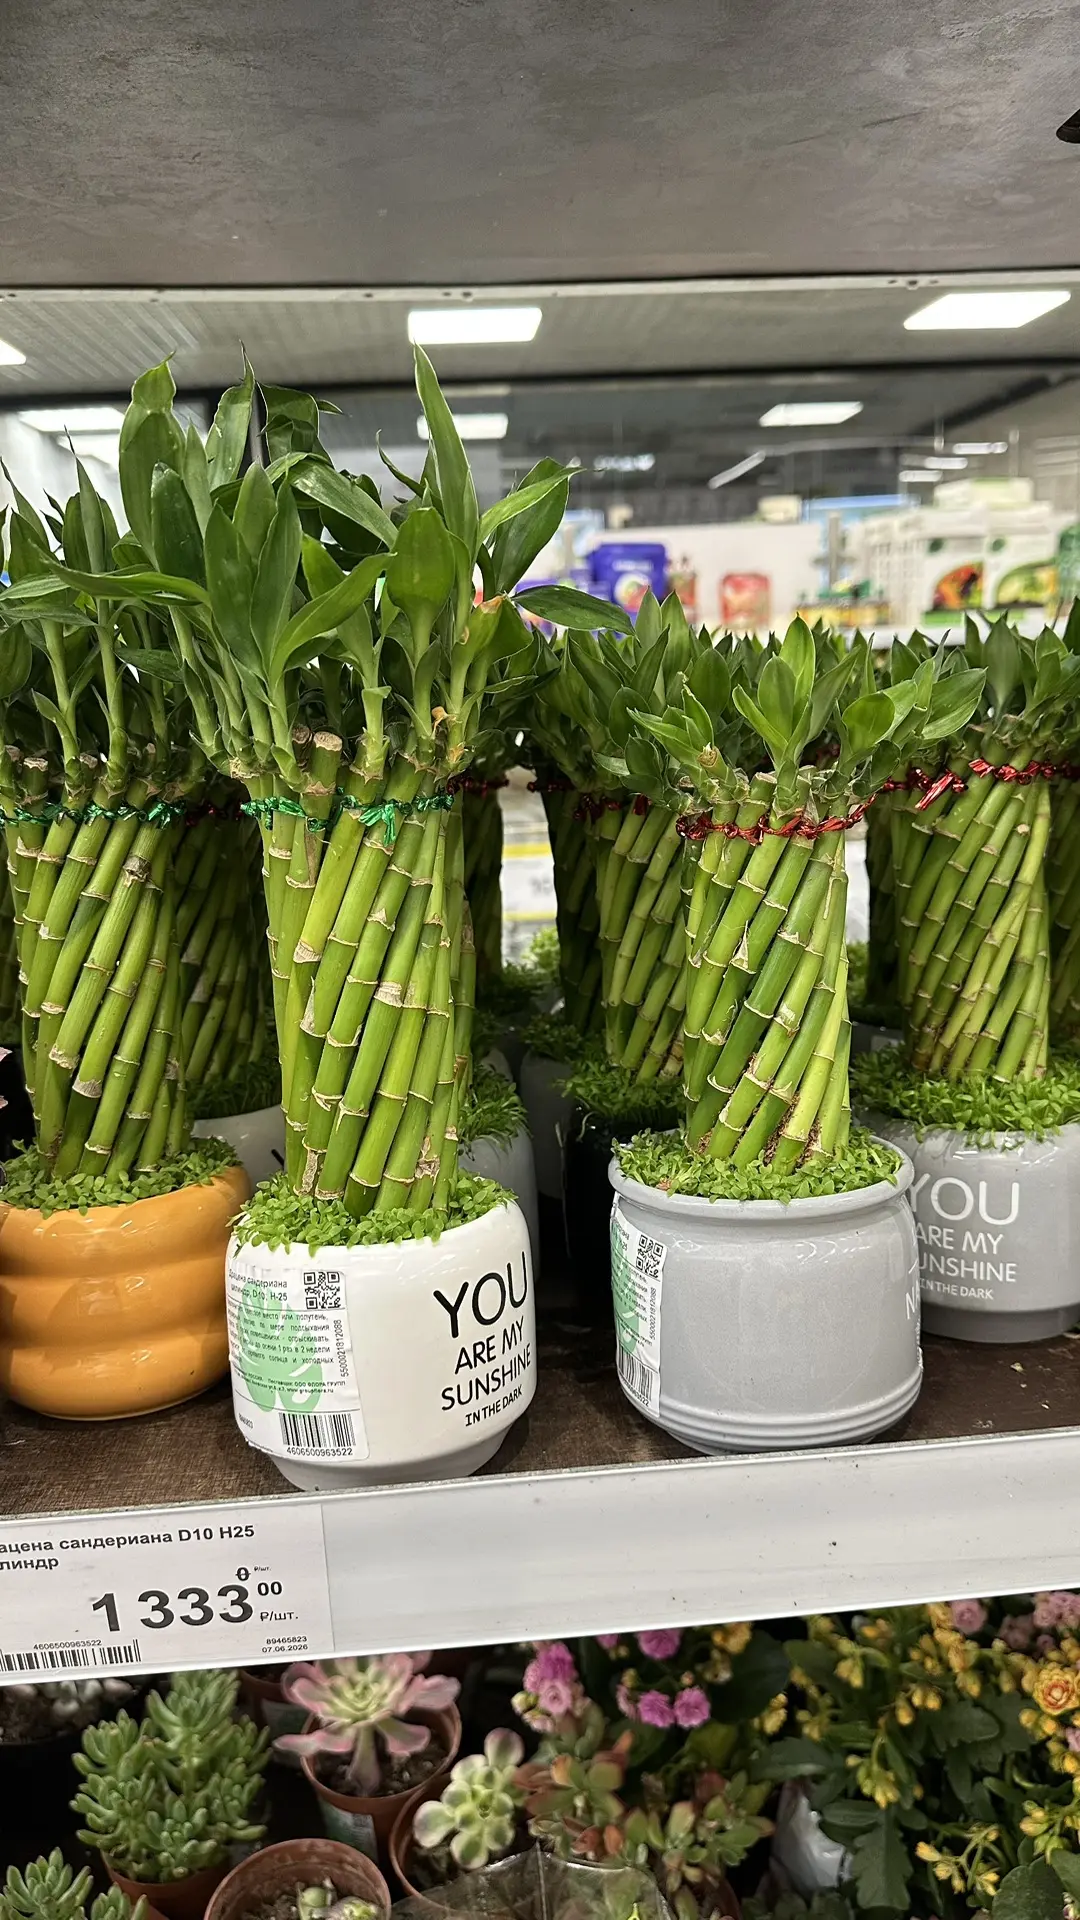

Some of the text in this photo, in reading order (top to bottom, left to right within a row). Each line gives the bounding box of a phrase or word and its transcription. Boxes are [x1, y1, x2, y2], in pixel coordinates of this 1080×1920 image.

[909, 1173, 1020, 1225] YOU
[916, 1222, 1004, 1255] ARE MY
[247, 1276, 288, 1289] сандериана
[920, 1278, 994, 1300] IN THE DARK
[433, 1251, 528, 1339] YOU
[455, 1315, 524, 1375] ARE MY
[301, 1357, 334, 1365] холодных
[441, 1343, 531, 1411] SUNSHINE
[465, 1384, 523, 1427] IN THE DARK
[286, 1446, 353, 1457] 4606500963522
[59, 1531, 173, 1550] сандериана
[178, 1527, 214, 1542] D10
[219, 1525, 255, 1540] H25
[257, 1581, 282, 1596] 00
[33, 1639, 102, 1650] 4606500963522
[261, 1643, 309, 1653] 07.06.2026
[266, 1635, 308, 1645] 89465823
